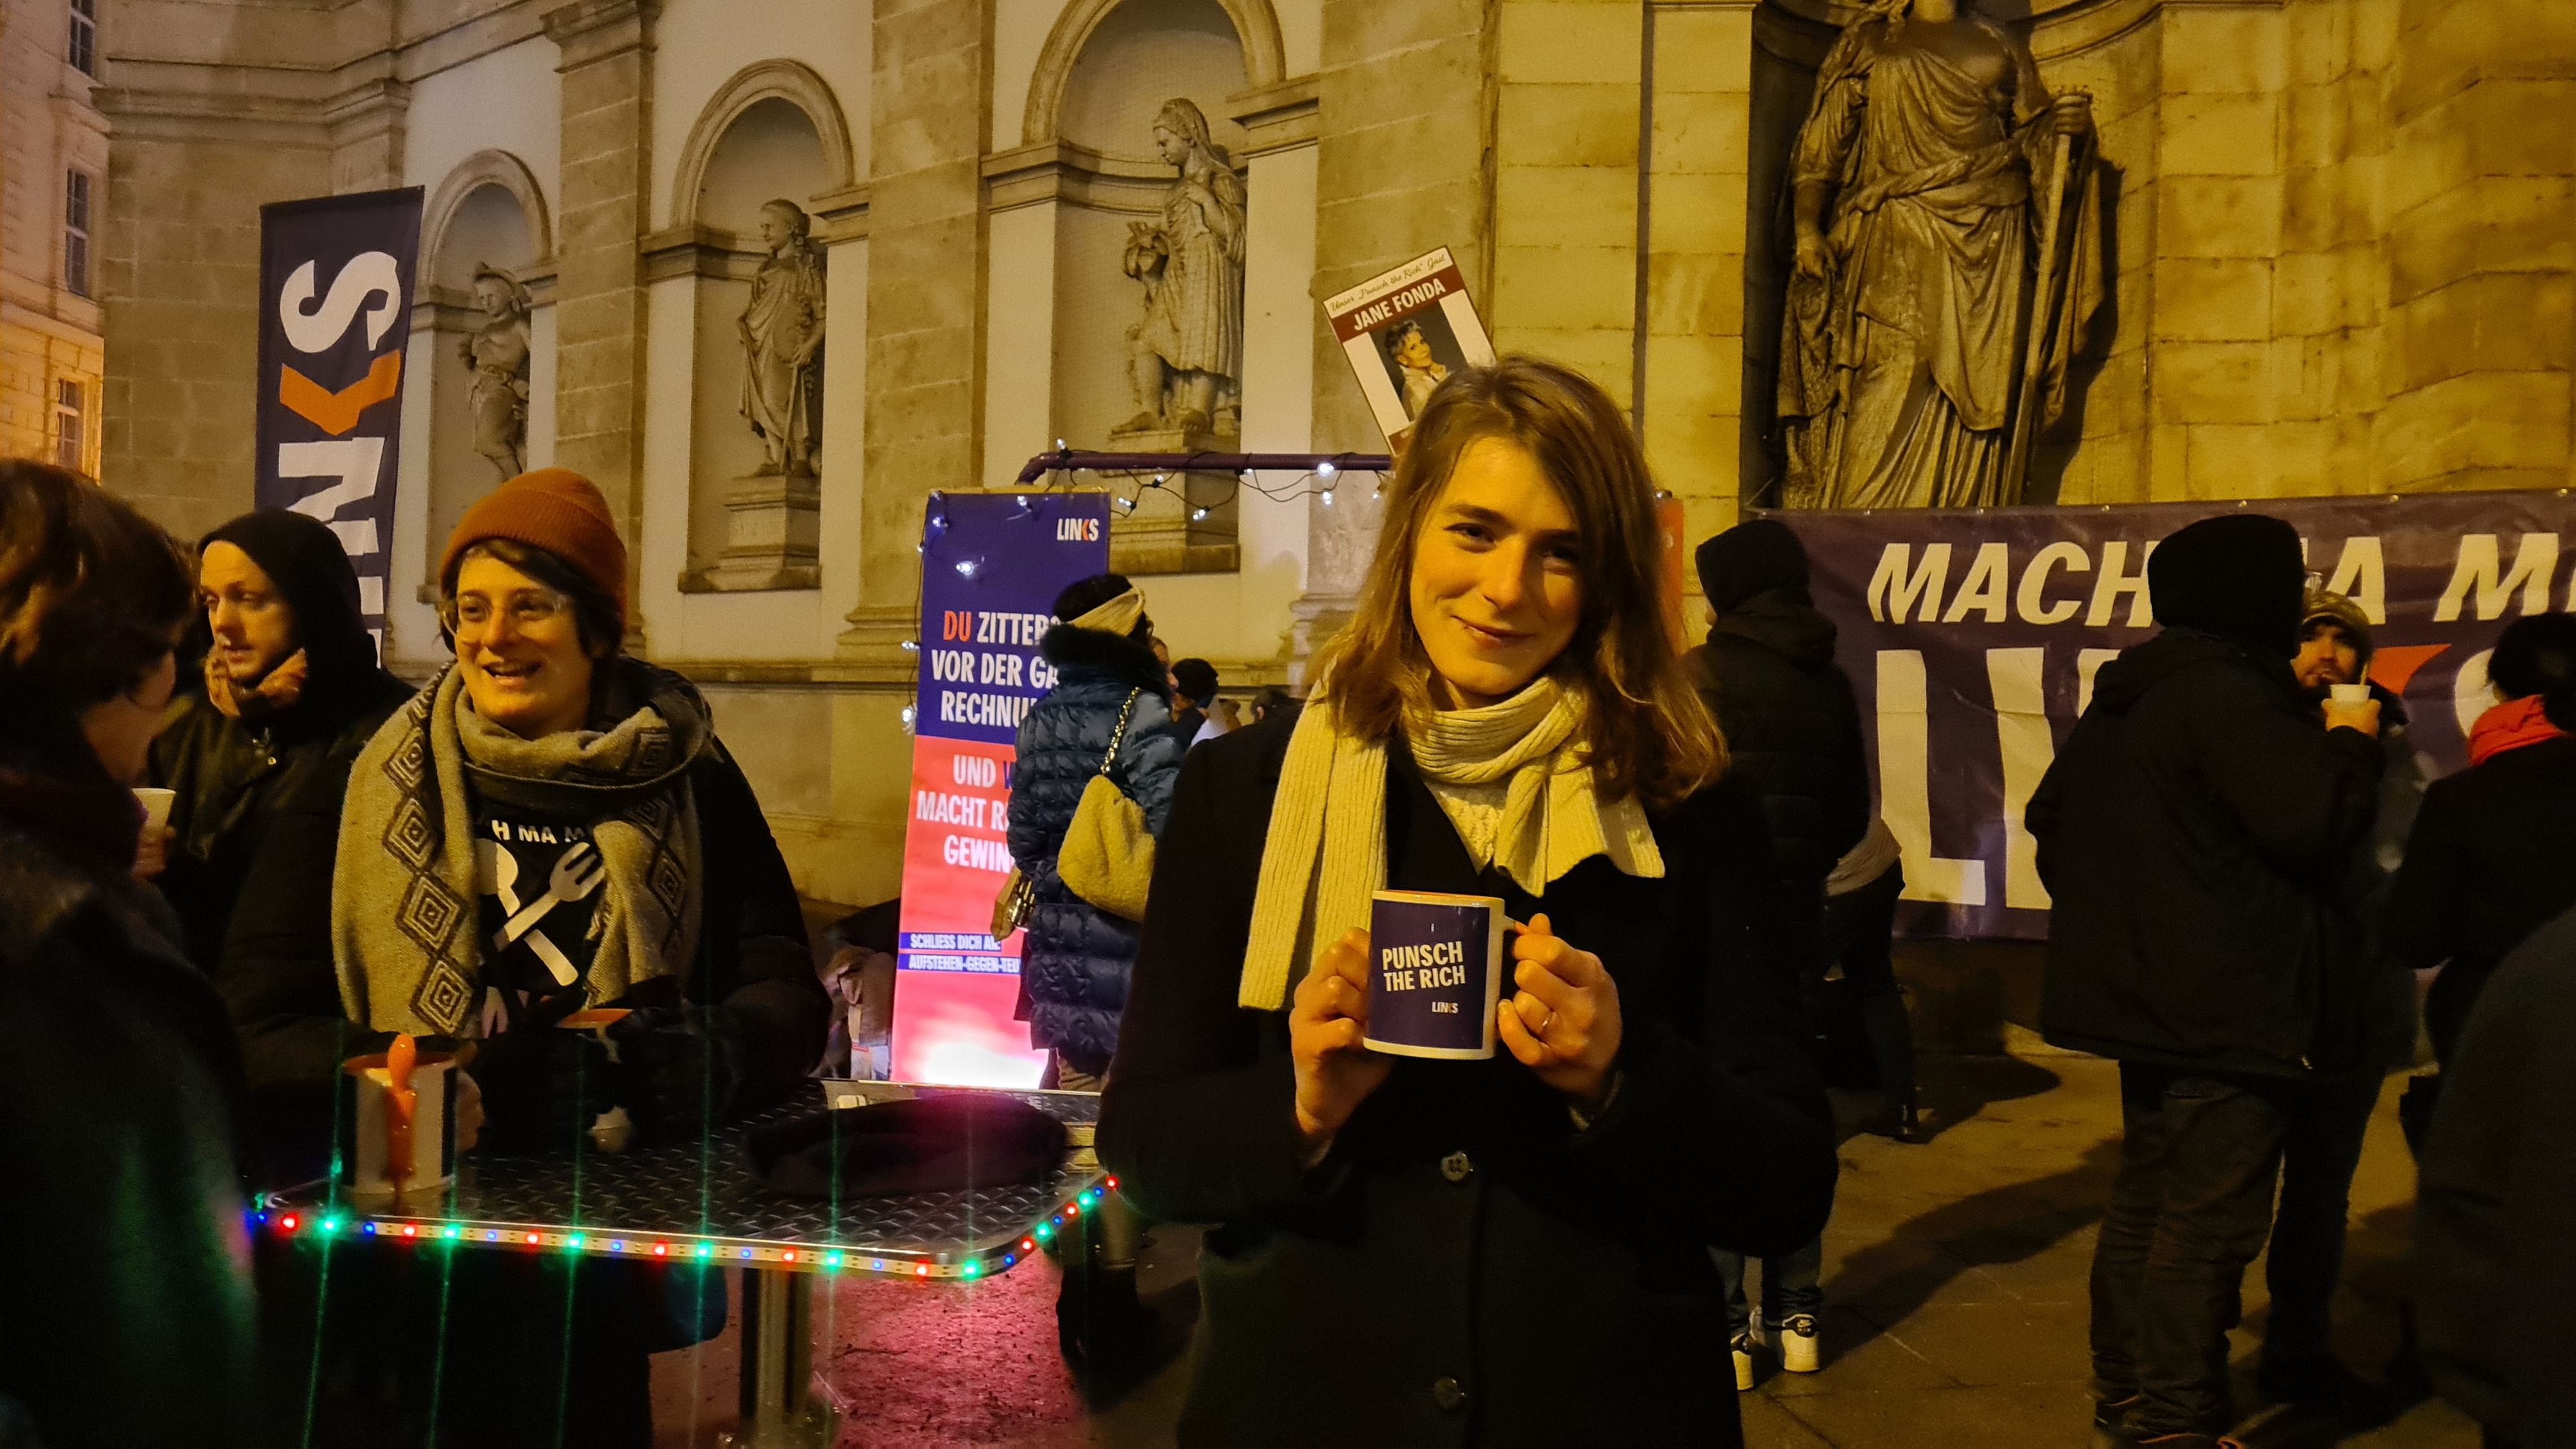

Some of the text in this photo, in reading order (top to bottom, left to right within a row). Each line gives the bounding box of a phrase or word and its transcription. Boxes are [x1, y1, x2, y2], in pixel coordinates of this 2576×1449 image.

[1353, 278, 1446, 331] JANE FONDA
[1057, 518, 1099, 541] LINKS
[1868, 540, 2160, 628] MACH
[943, 611, 1061, 646] DU ZITTER
[931, 650, 974, 683] VOR
[981, 652, 1023, 687] DER
[953, 754, 996, 788] UND
[916, 790, 987, 828] MACHT
[518, 824, 558, 844] MA
[943, 834, 1016, 874] GEWIN
[910, 933, 956, 950] SCHLIESS
[957, 934, 982, 951] DICH
[1382, 941, 1464, 971] PUNSCH
[1383, 965, 1466, 992] THE RICH
[1432, 1001, 1459, 1014] LINKS
